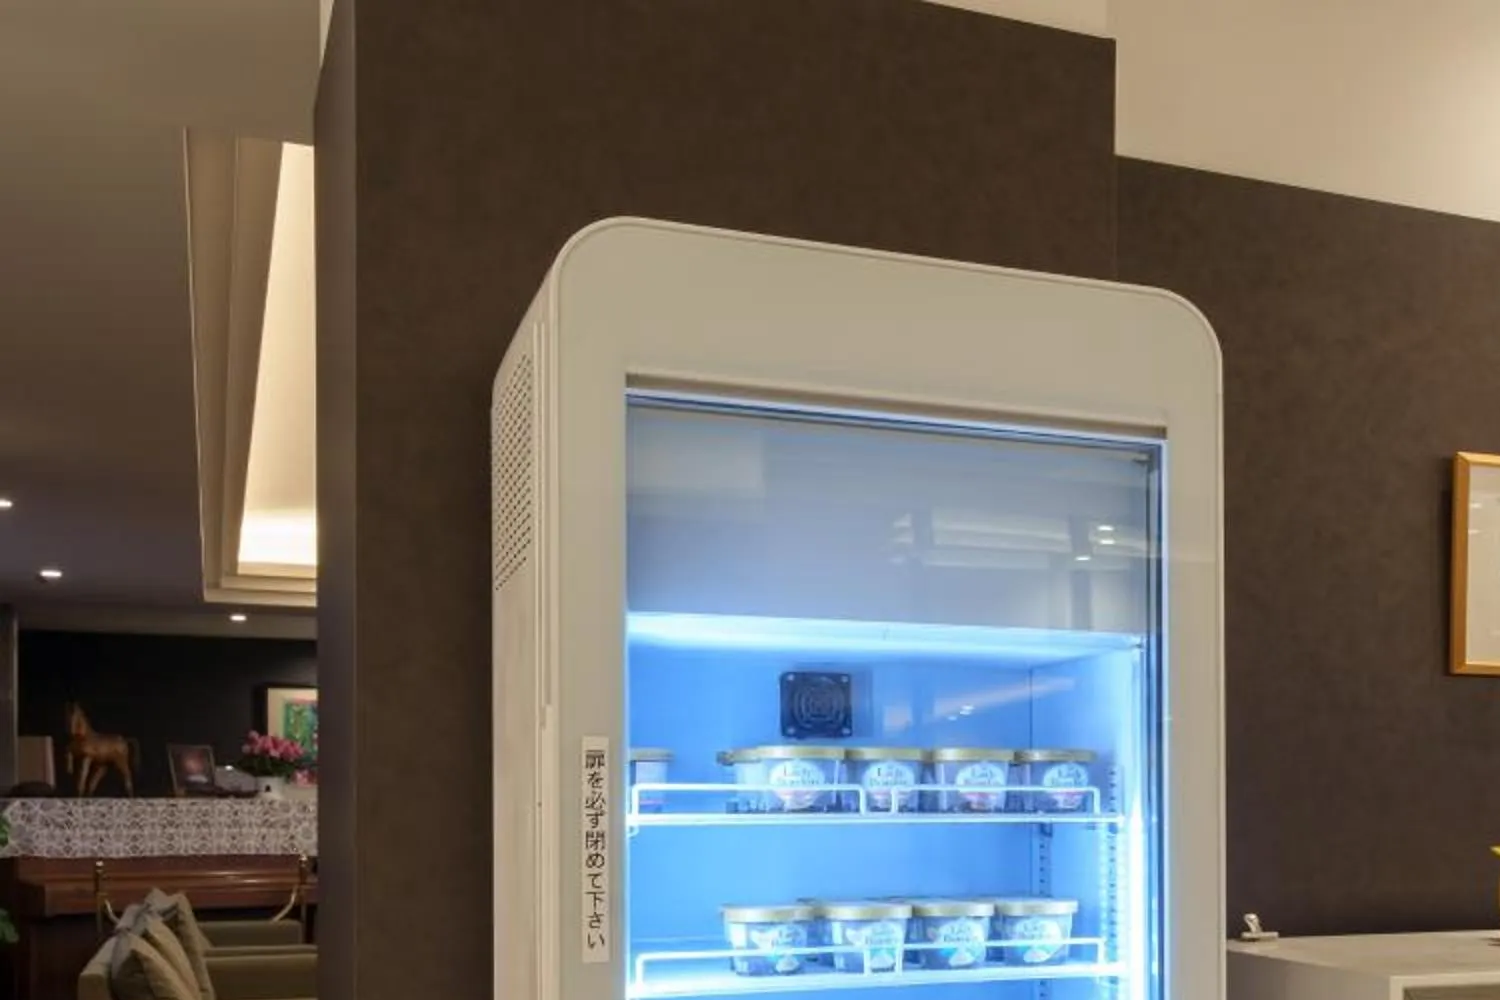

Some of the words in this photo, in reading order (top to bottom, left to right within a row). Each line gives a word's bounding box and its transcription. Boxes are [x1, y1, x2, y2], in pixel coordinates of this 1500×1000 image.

[584, 749, 606, 950] 扉を必ず閉めて下さい
